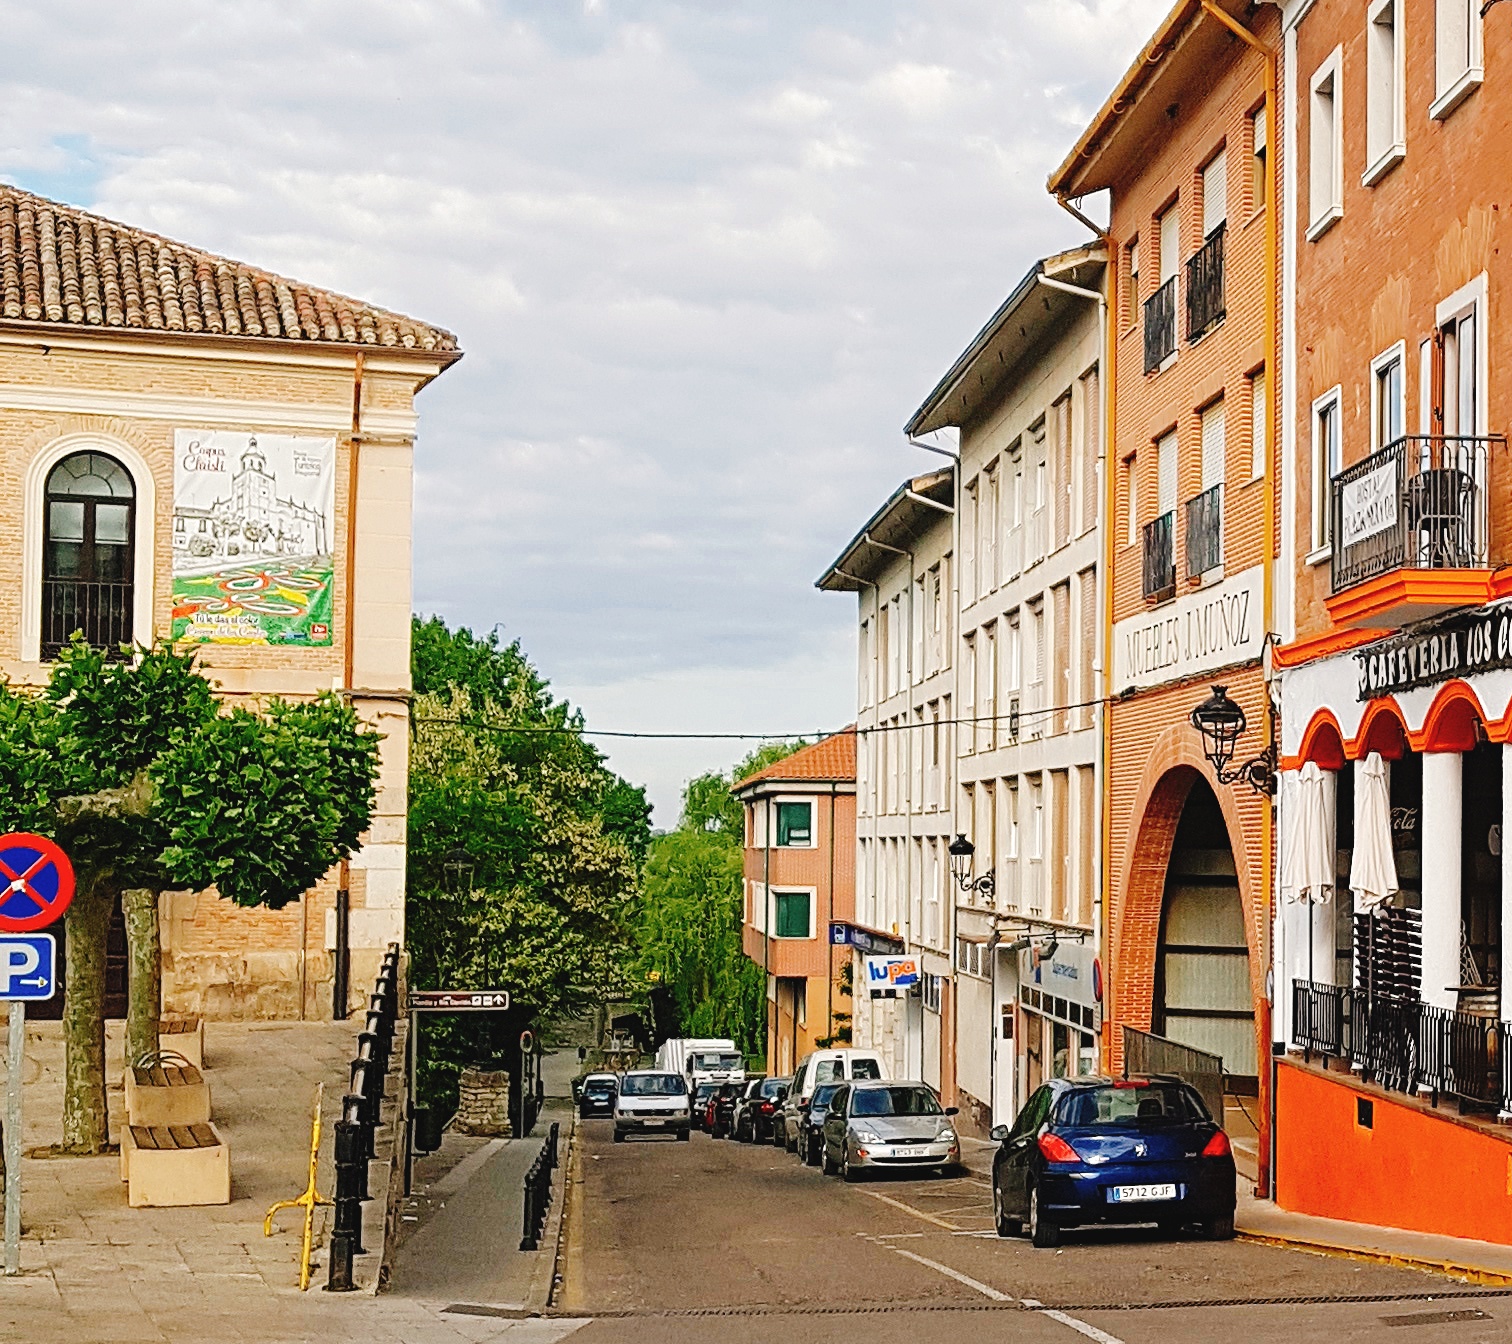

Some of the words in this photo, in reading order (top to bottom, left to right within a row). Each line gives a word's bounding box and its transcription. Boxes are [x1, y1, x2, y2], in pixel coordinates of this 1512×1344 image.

[1126, 616, 1179, 679] MUEBLES
[1195, 589, 1250, 659] MUÑOZ
[1369, 631, 1460, 691] CAFETERIA
[1466, 620, 1493, 667] LOS
[0, 942, 40, 993] P
[868, 960, 917, 985] lupa
[1122, 1186, 1148, 1198] 5712
[1151, 1185, 1171, 1197] GJF
